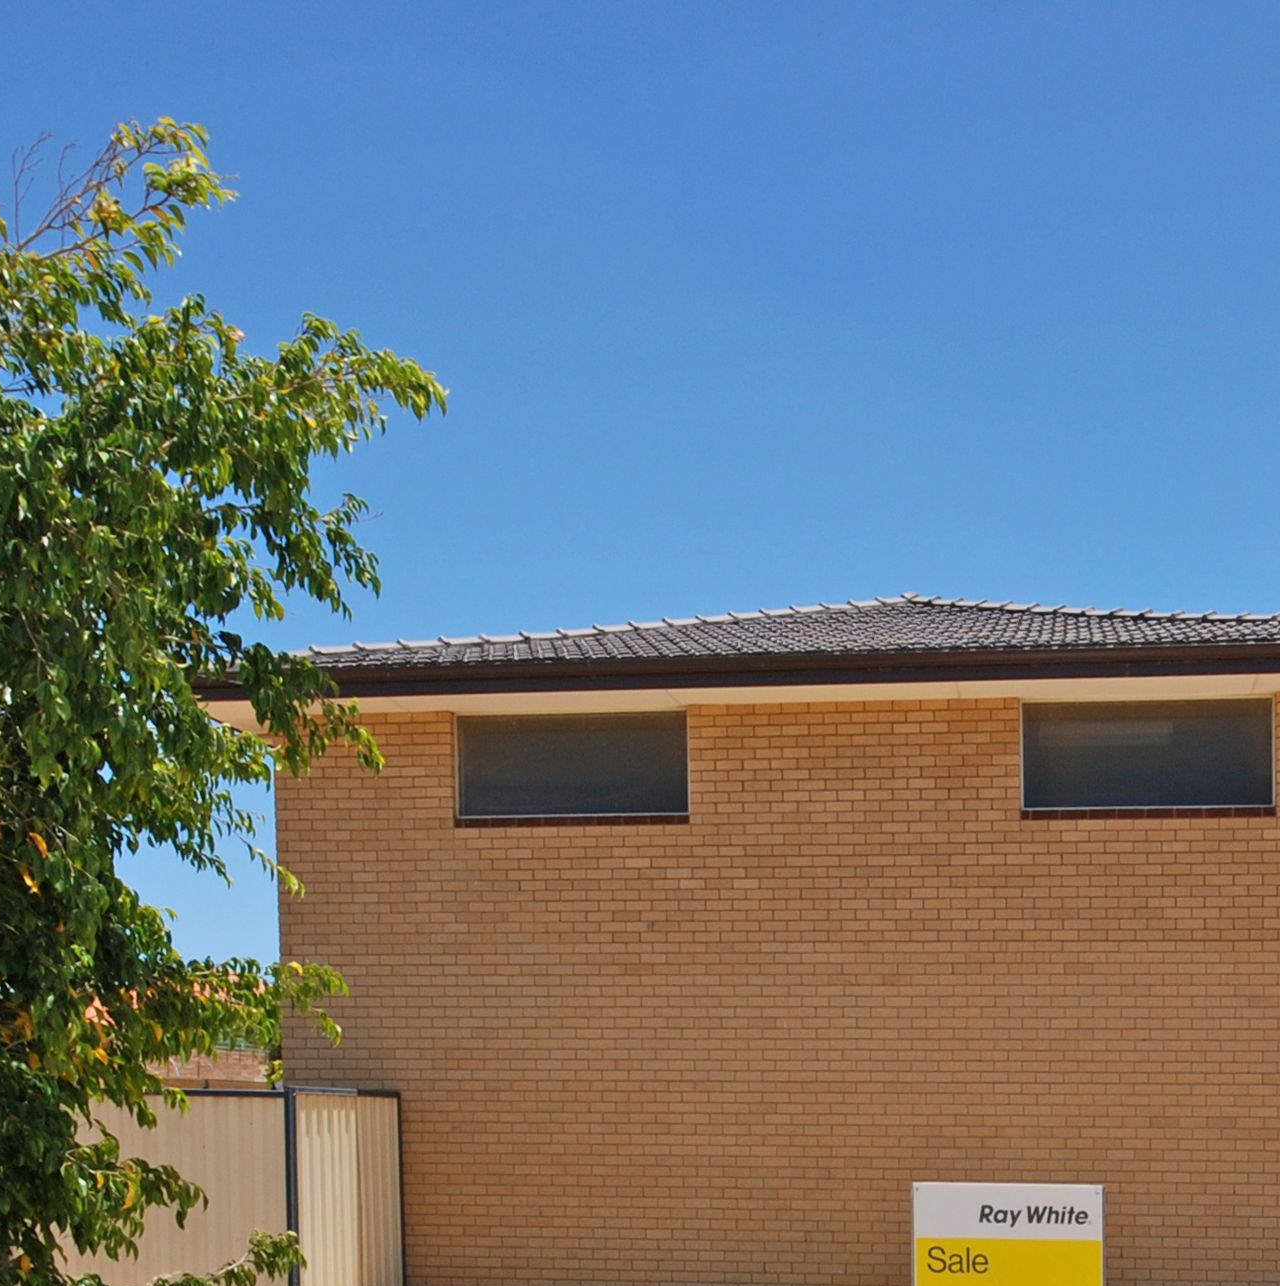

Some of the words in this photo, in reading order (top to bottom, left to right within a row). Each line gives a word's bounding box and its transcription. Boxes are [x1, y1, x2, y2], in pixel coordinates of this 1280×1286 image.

[978, 1204, 1021, 1228] Ray
[1026, 1205, 1089, 1225] White
[927, 1246, 989, 1274] Sale
